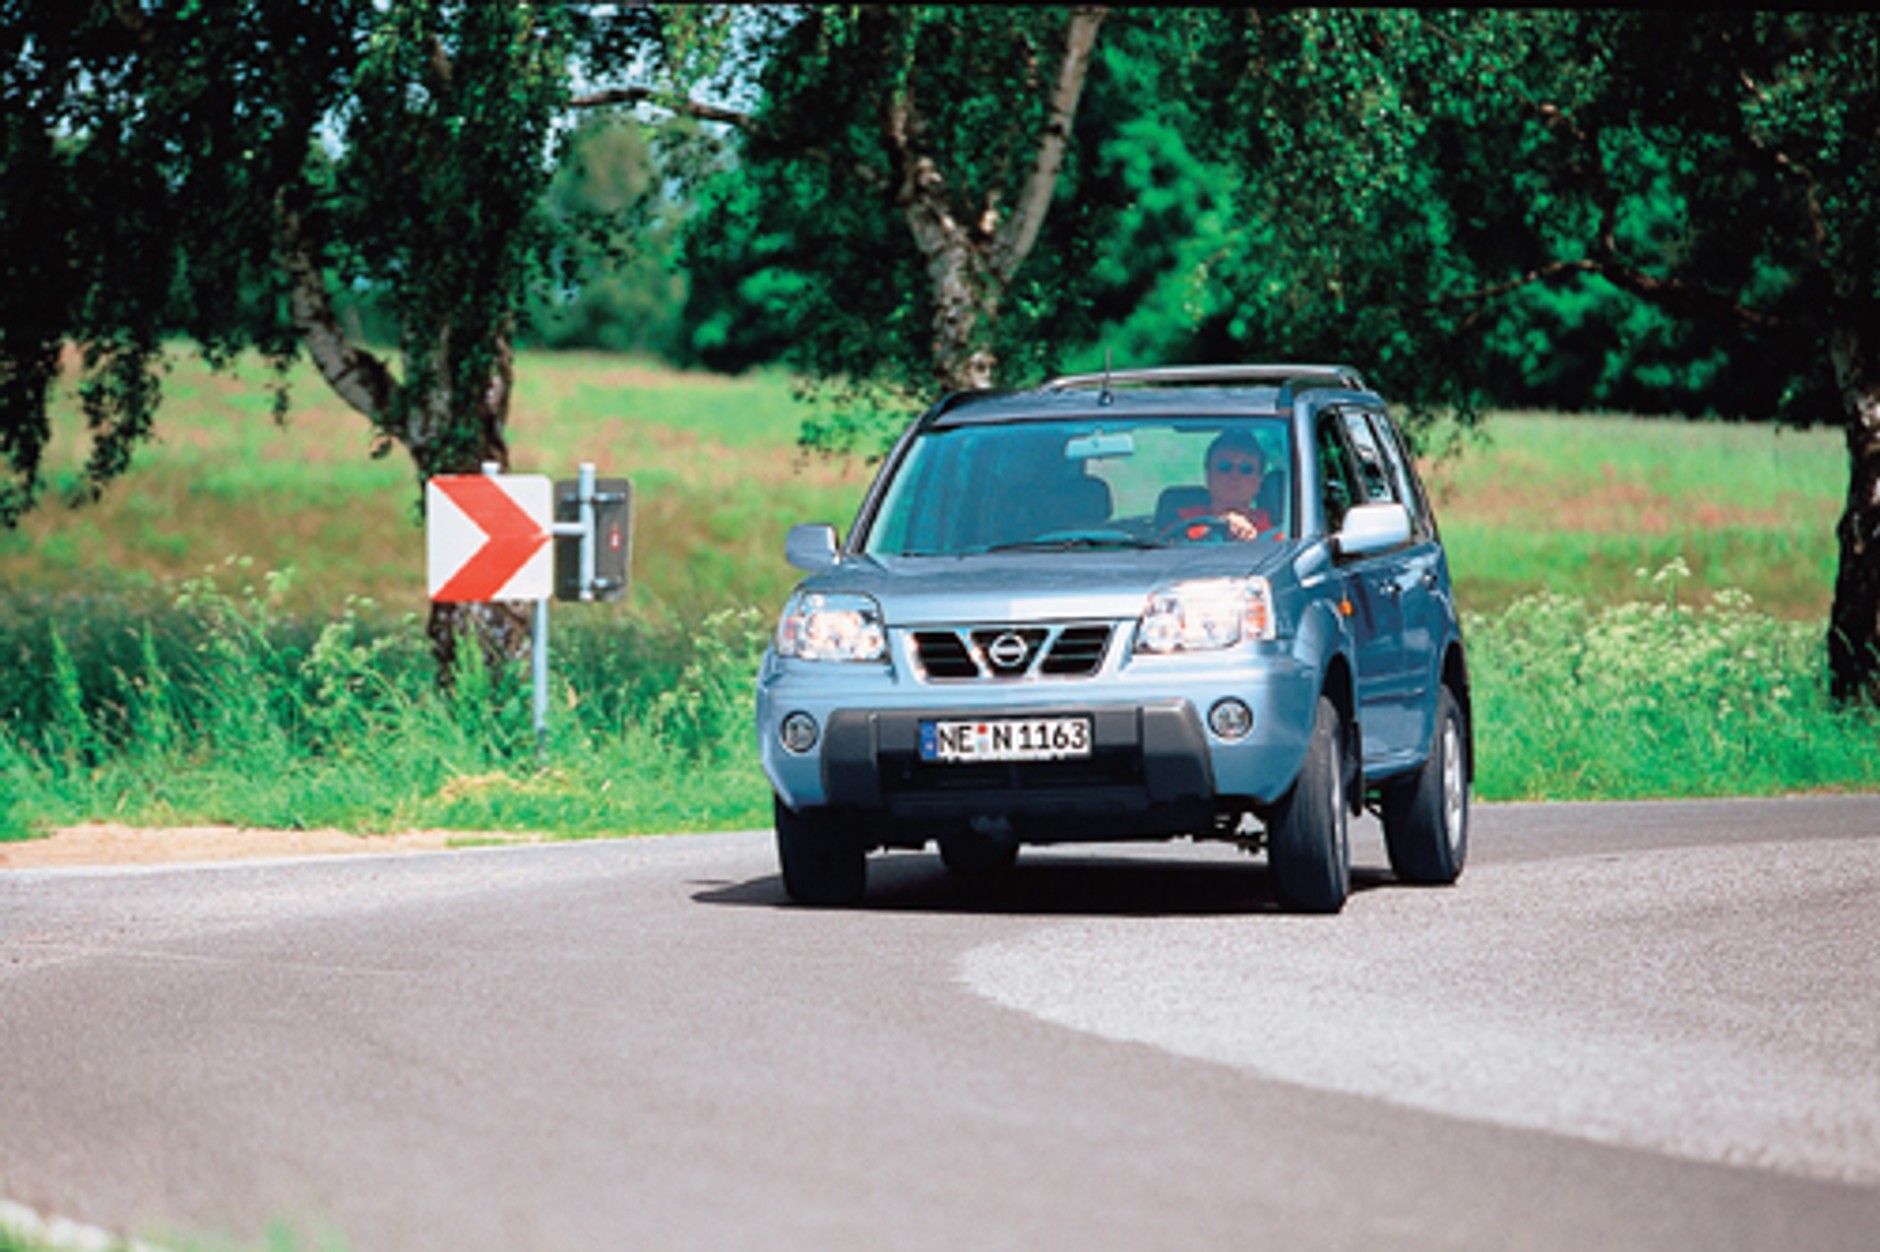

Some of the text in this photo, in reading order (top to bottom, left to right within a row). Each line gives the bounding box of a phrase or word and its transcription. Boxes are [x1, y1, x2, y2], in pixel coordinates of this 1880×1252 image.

[939, 721, 1088, 753] NE N 1163
